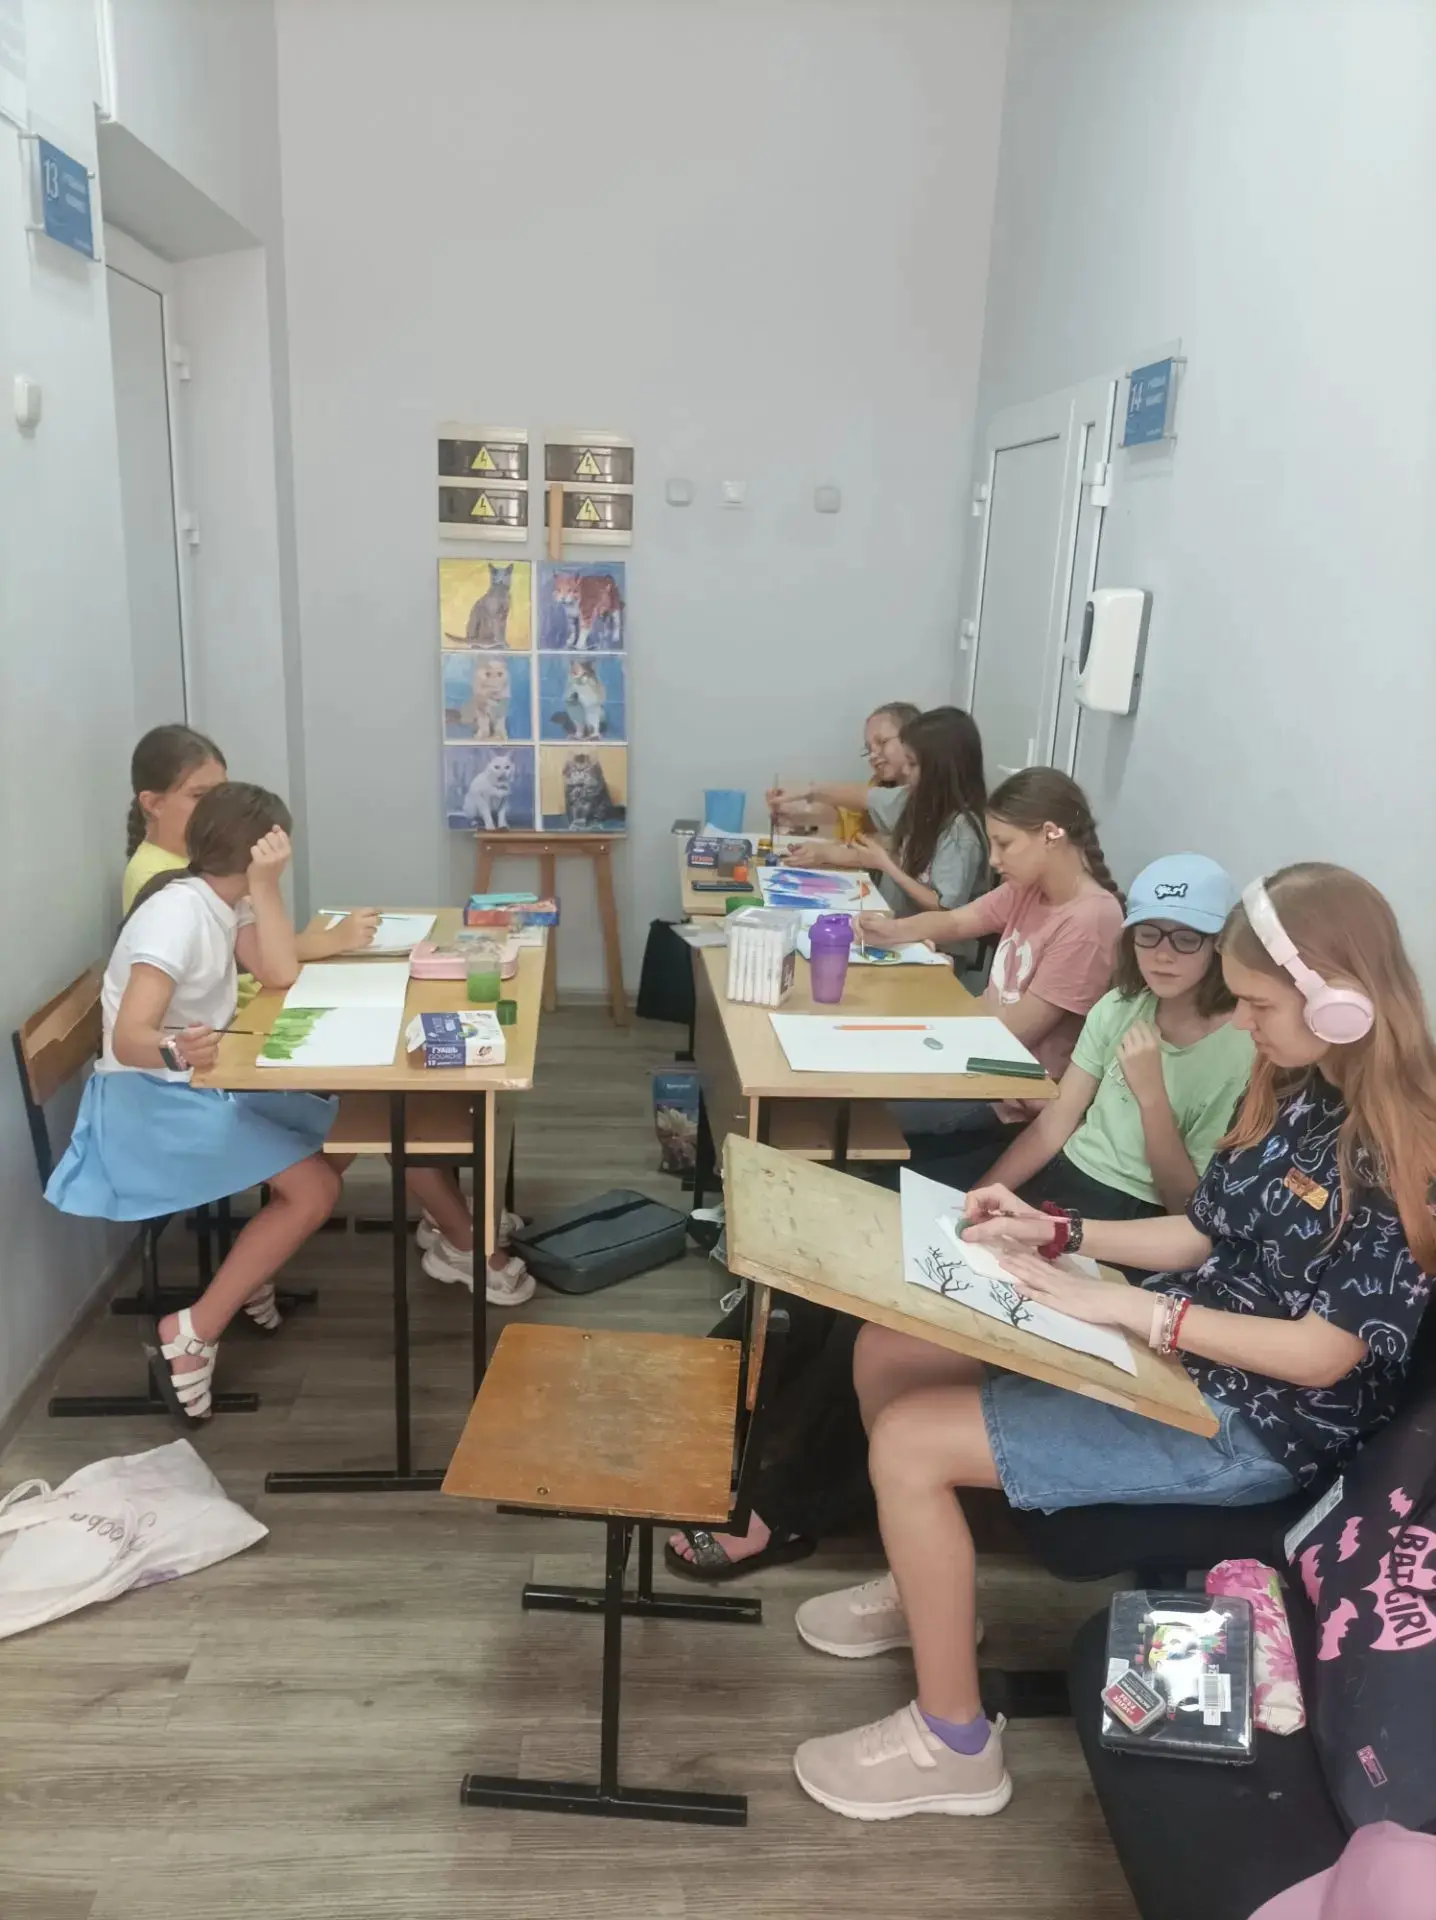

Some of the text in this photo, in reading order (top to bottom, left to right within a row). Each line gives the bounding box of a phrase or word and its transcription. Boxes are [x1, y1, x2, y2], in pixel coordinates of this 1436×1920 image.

[44, 158, 60, 200] 13
[432, 1046, 458, 1054] ГУАШЬ
[1384, 1533, 1429, 1583] BAT
[1384, 1588, 1432, 1646] GIRL
